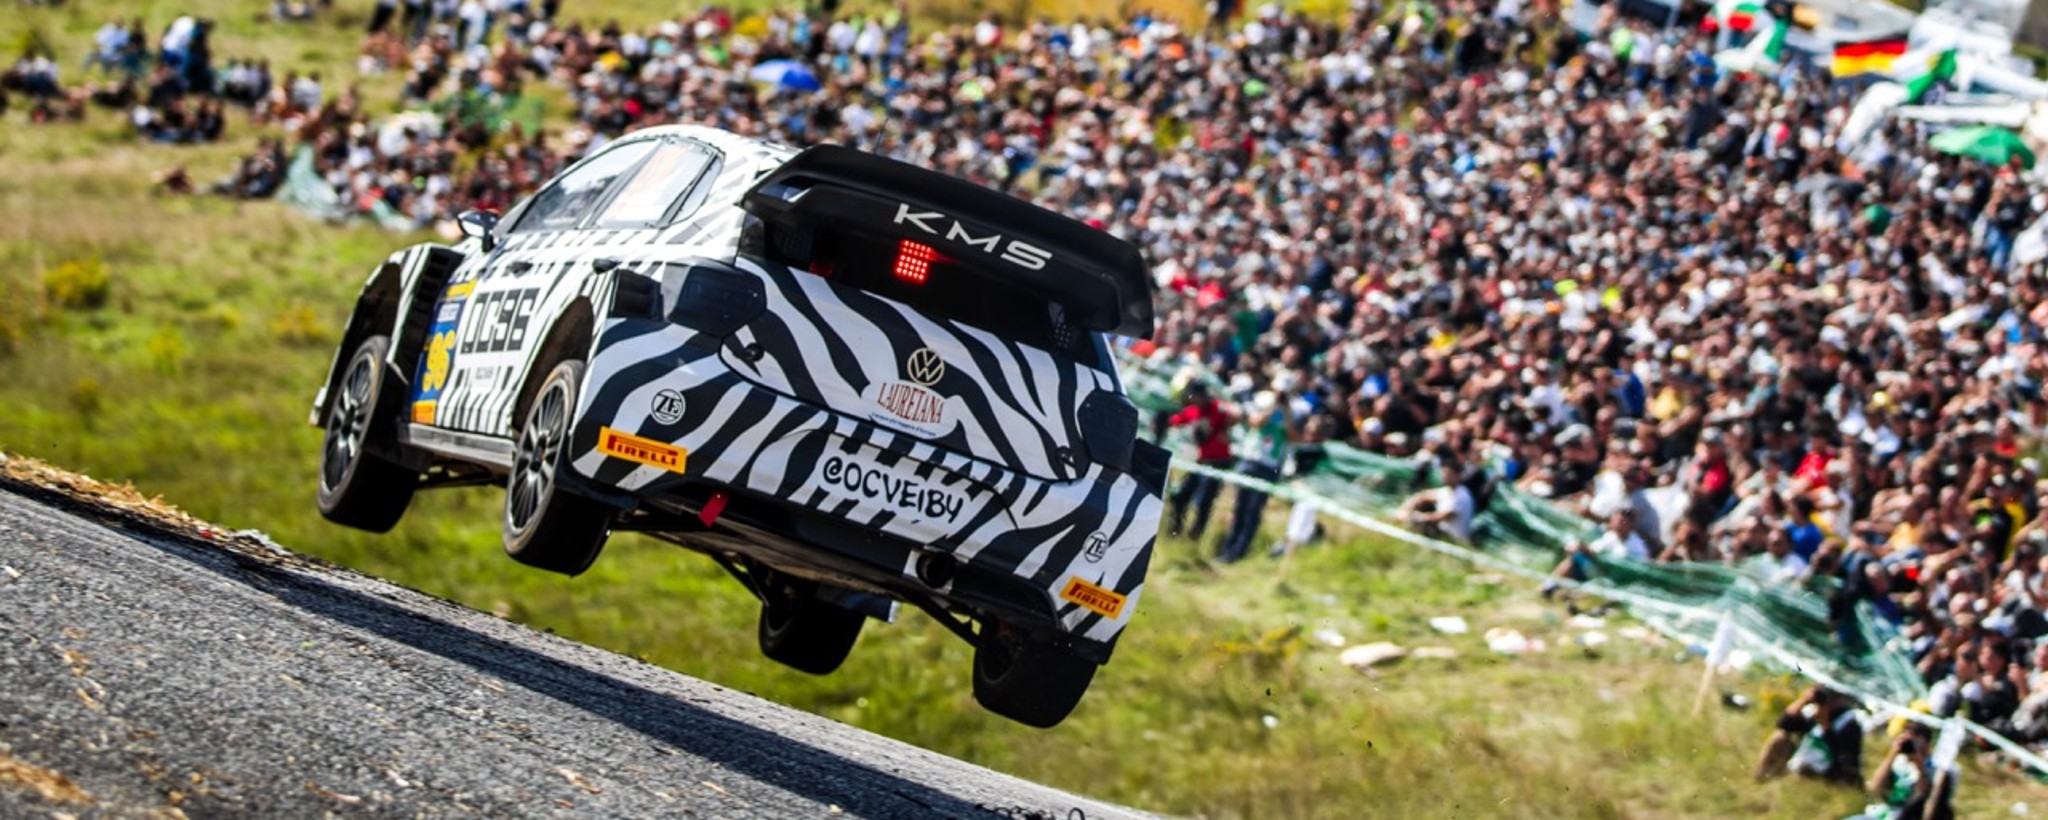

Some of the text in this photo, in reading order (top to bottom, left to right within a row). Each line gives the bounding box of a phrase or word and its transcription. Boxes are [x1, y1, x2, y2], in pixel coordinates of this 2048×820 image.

[893, 203, 1053, 271] KMS
[460, 287, 540, 354] OC96
[652, 391, 684, 420] ZF
[877, 382, 944, 424] LAURETANA
[607, 434, 678, 466] PIRELLI
[823, 456, 963, 523] @OCVEIBY
[1085, 534, 1108, 558] ZF
[1068, 582, 1119, 613] PIRELLI
